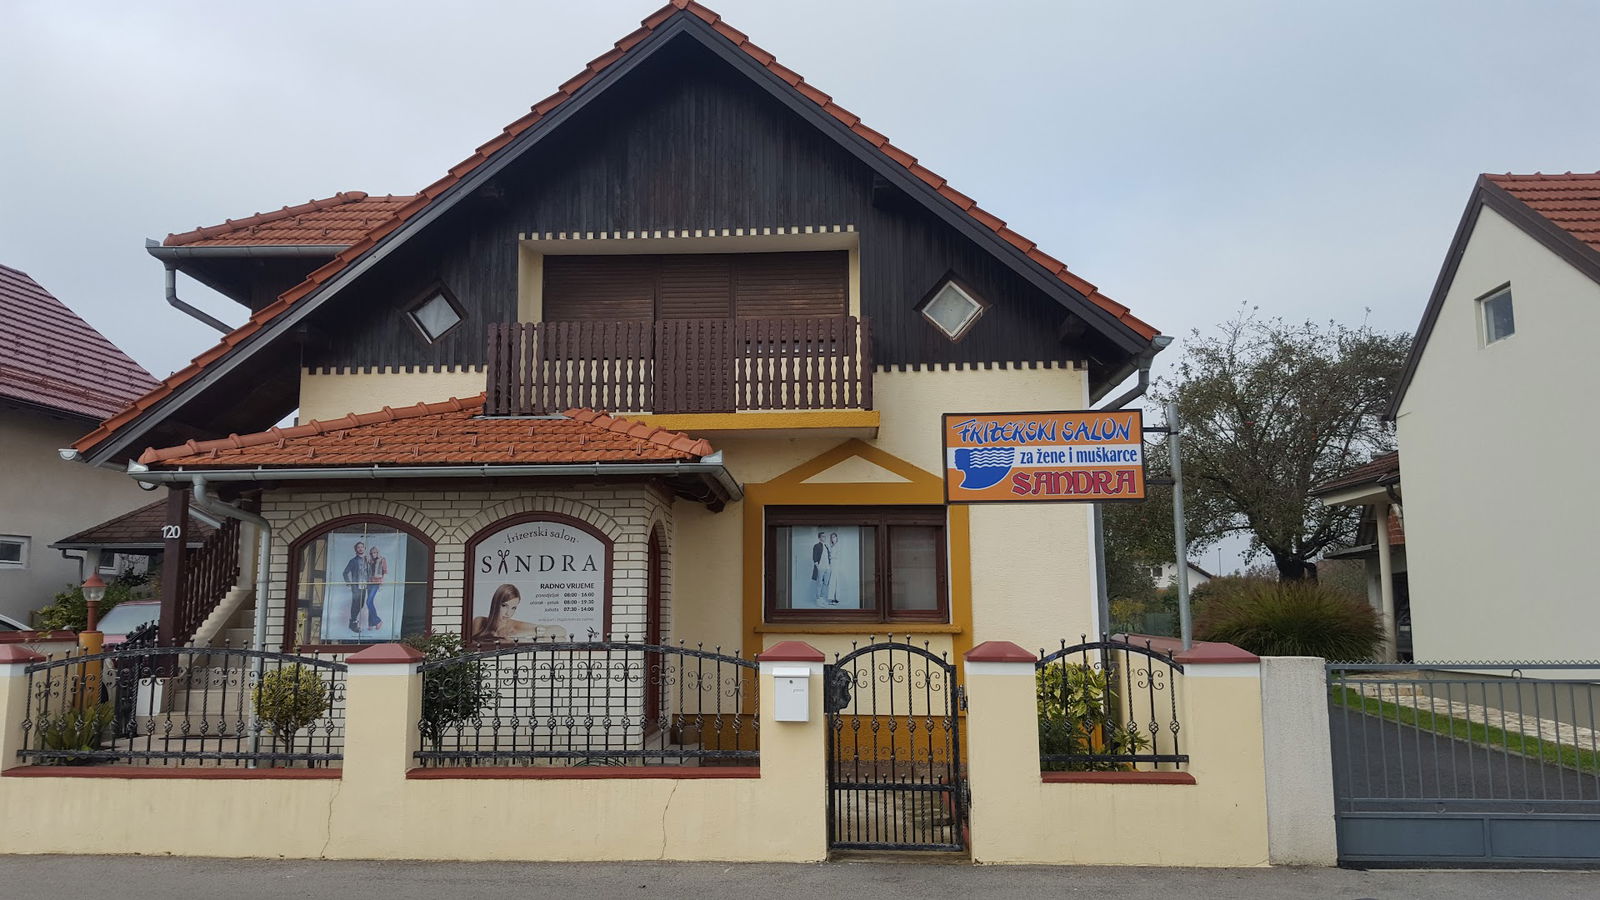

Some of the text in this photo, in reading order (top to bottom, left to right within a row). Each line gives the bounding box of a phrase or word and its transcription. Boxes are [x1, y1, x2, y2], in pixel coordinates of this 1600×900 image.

[1061, 416, 1132, 441] SALON
[1020, 446, 1137, 464] za žene i muškarce
[1011, 470, 1137, 496] SANDRA
[161, 525, 180, 538] 120
[550, 528, 576, 543] salon
